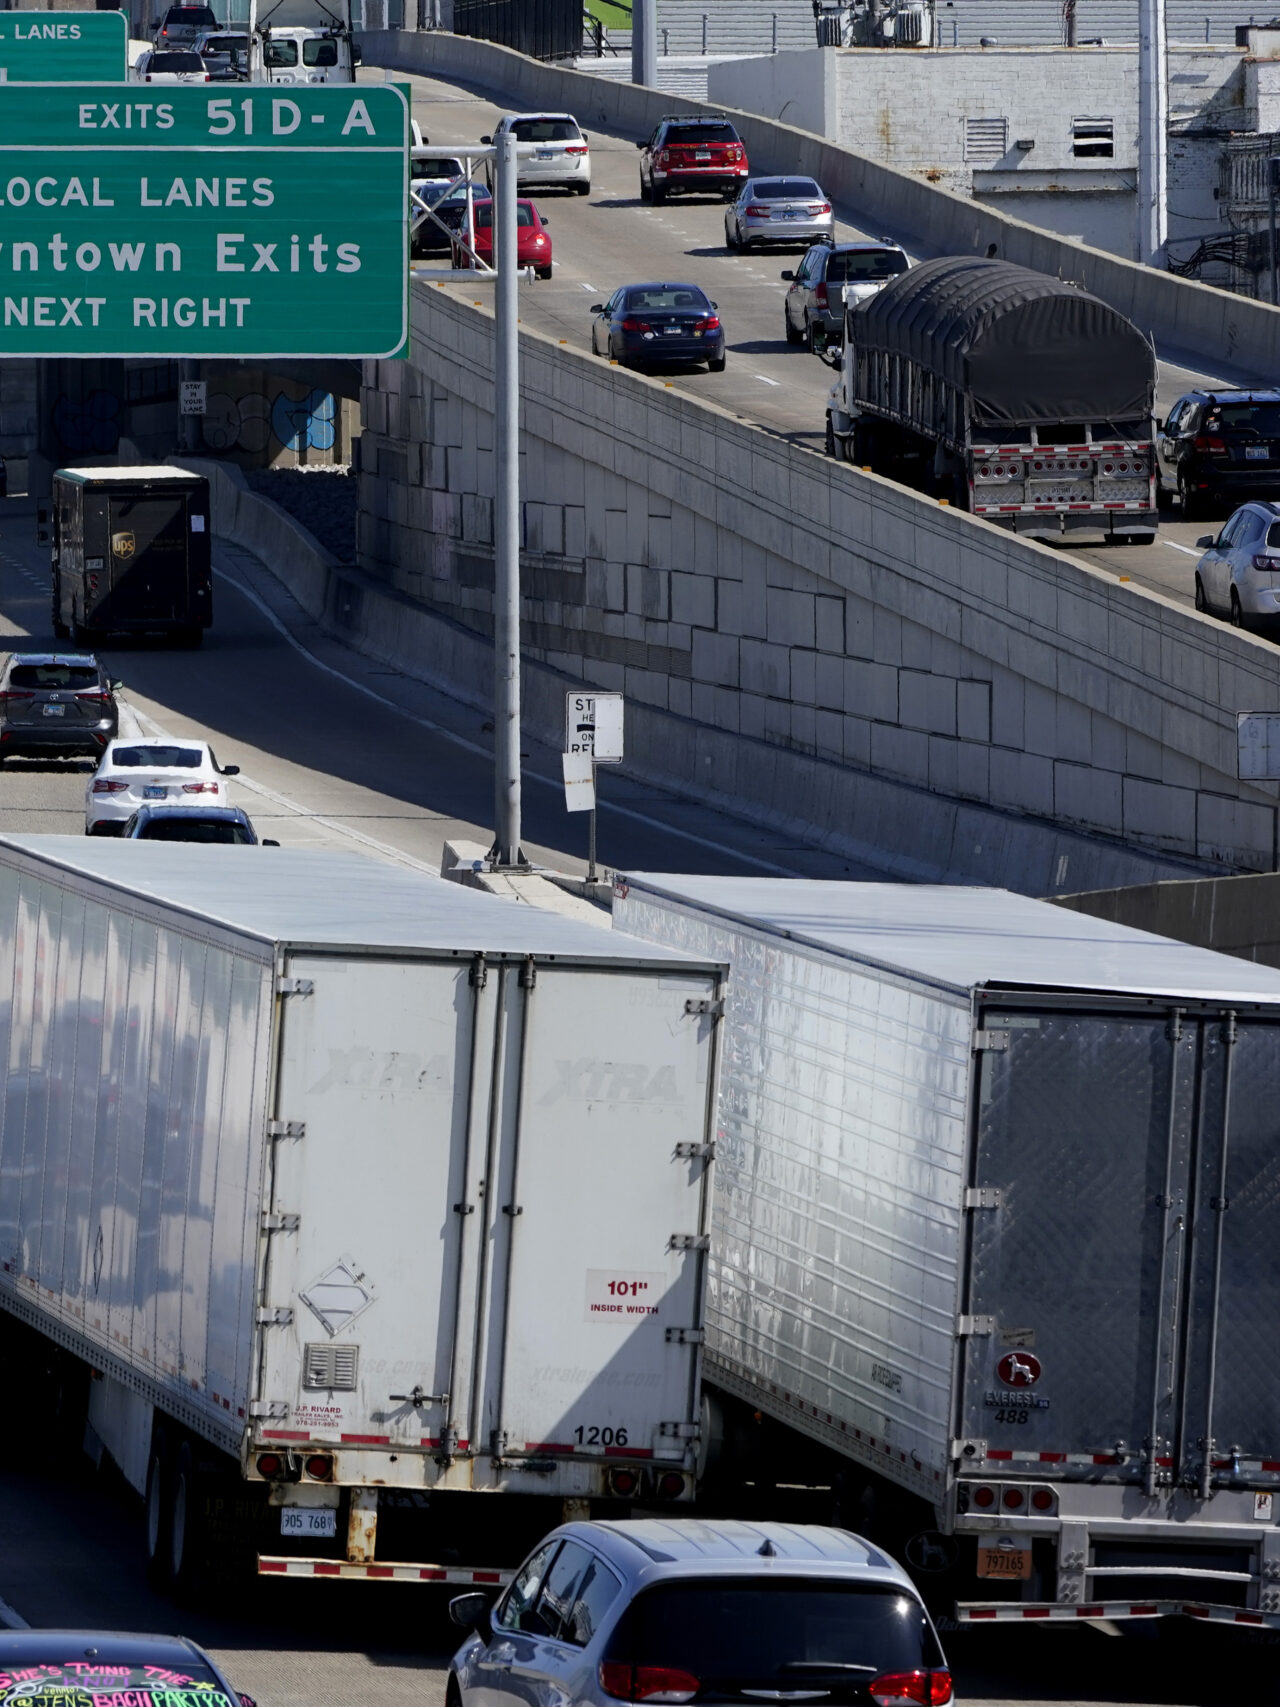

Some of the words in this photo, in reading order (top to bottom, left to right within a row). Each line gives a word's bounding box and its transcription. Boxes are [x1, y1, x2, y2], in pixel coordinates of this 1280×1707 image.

[16, 24, 81, 39] LANES
[80, 104, 174, 128] EXITS
[141, 178, 274, 206] LANES
[217, 234, 361, 272] Exits
[5, 297, 106, 326] NEXT
[134, 298, 250, 326] RIGHT
[575, 699, 595, 711] ST
[582, 714, 594, 722] HE
[581, 733, 594, 741] ON
[572, 744, 595, 757] RE
[591, 1303, 623, 1314] INSIDE
[626, 1304, 659, 1316] WIDTH
[986, 1391, 1038, 1403] EVEREST
[311, 1405, 342, 1414] RIVARD
[995, 1410, 1029, 1425] 488
[574, 1425, 629, 1447] 1206
[308, 1515, 327, 1529] 768
[985, 1555, 1024, 1570] 797165
[64, 1662, 132, 1677] TYING
[144, 1664, 195, 1686] THE
[63, 1676, 134, 1688] KNOT
